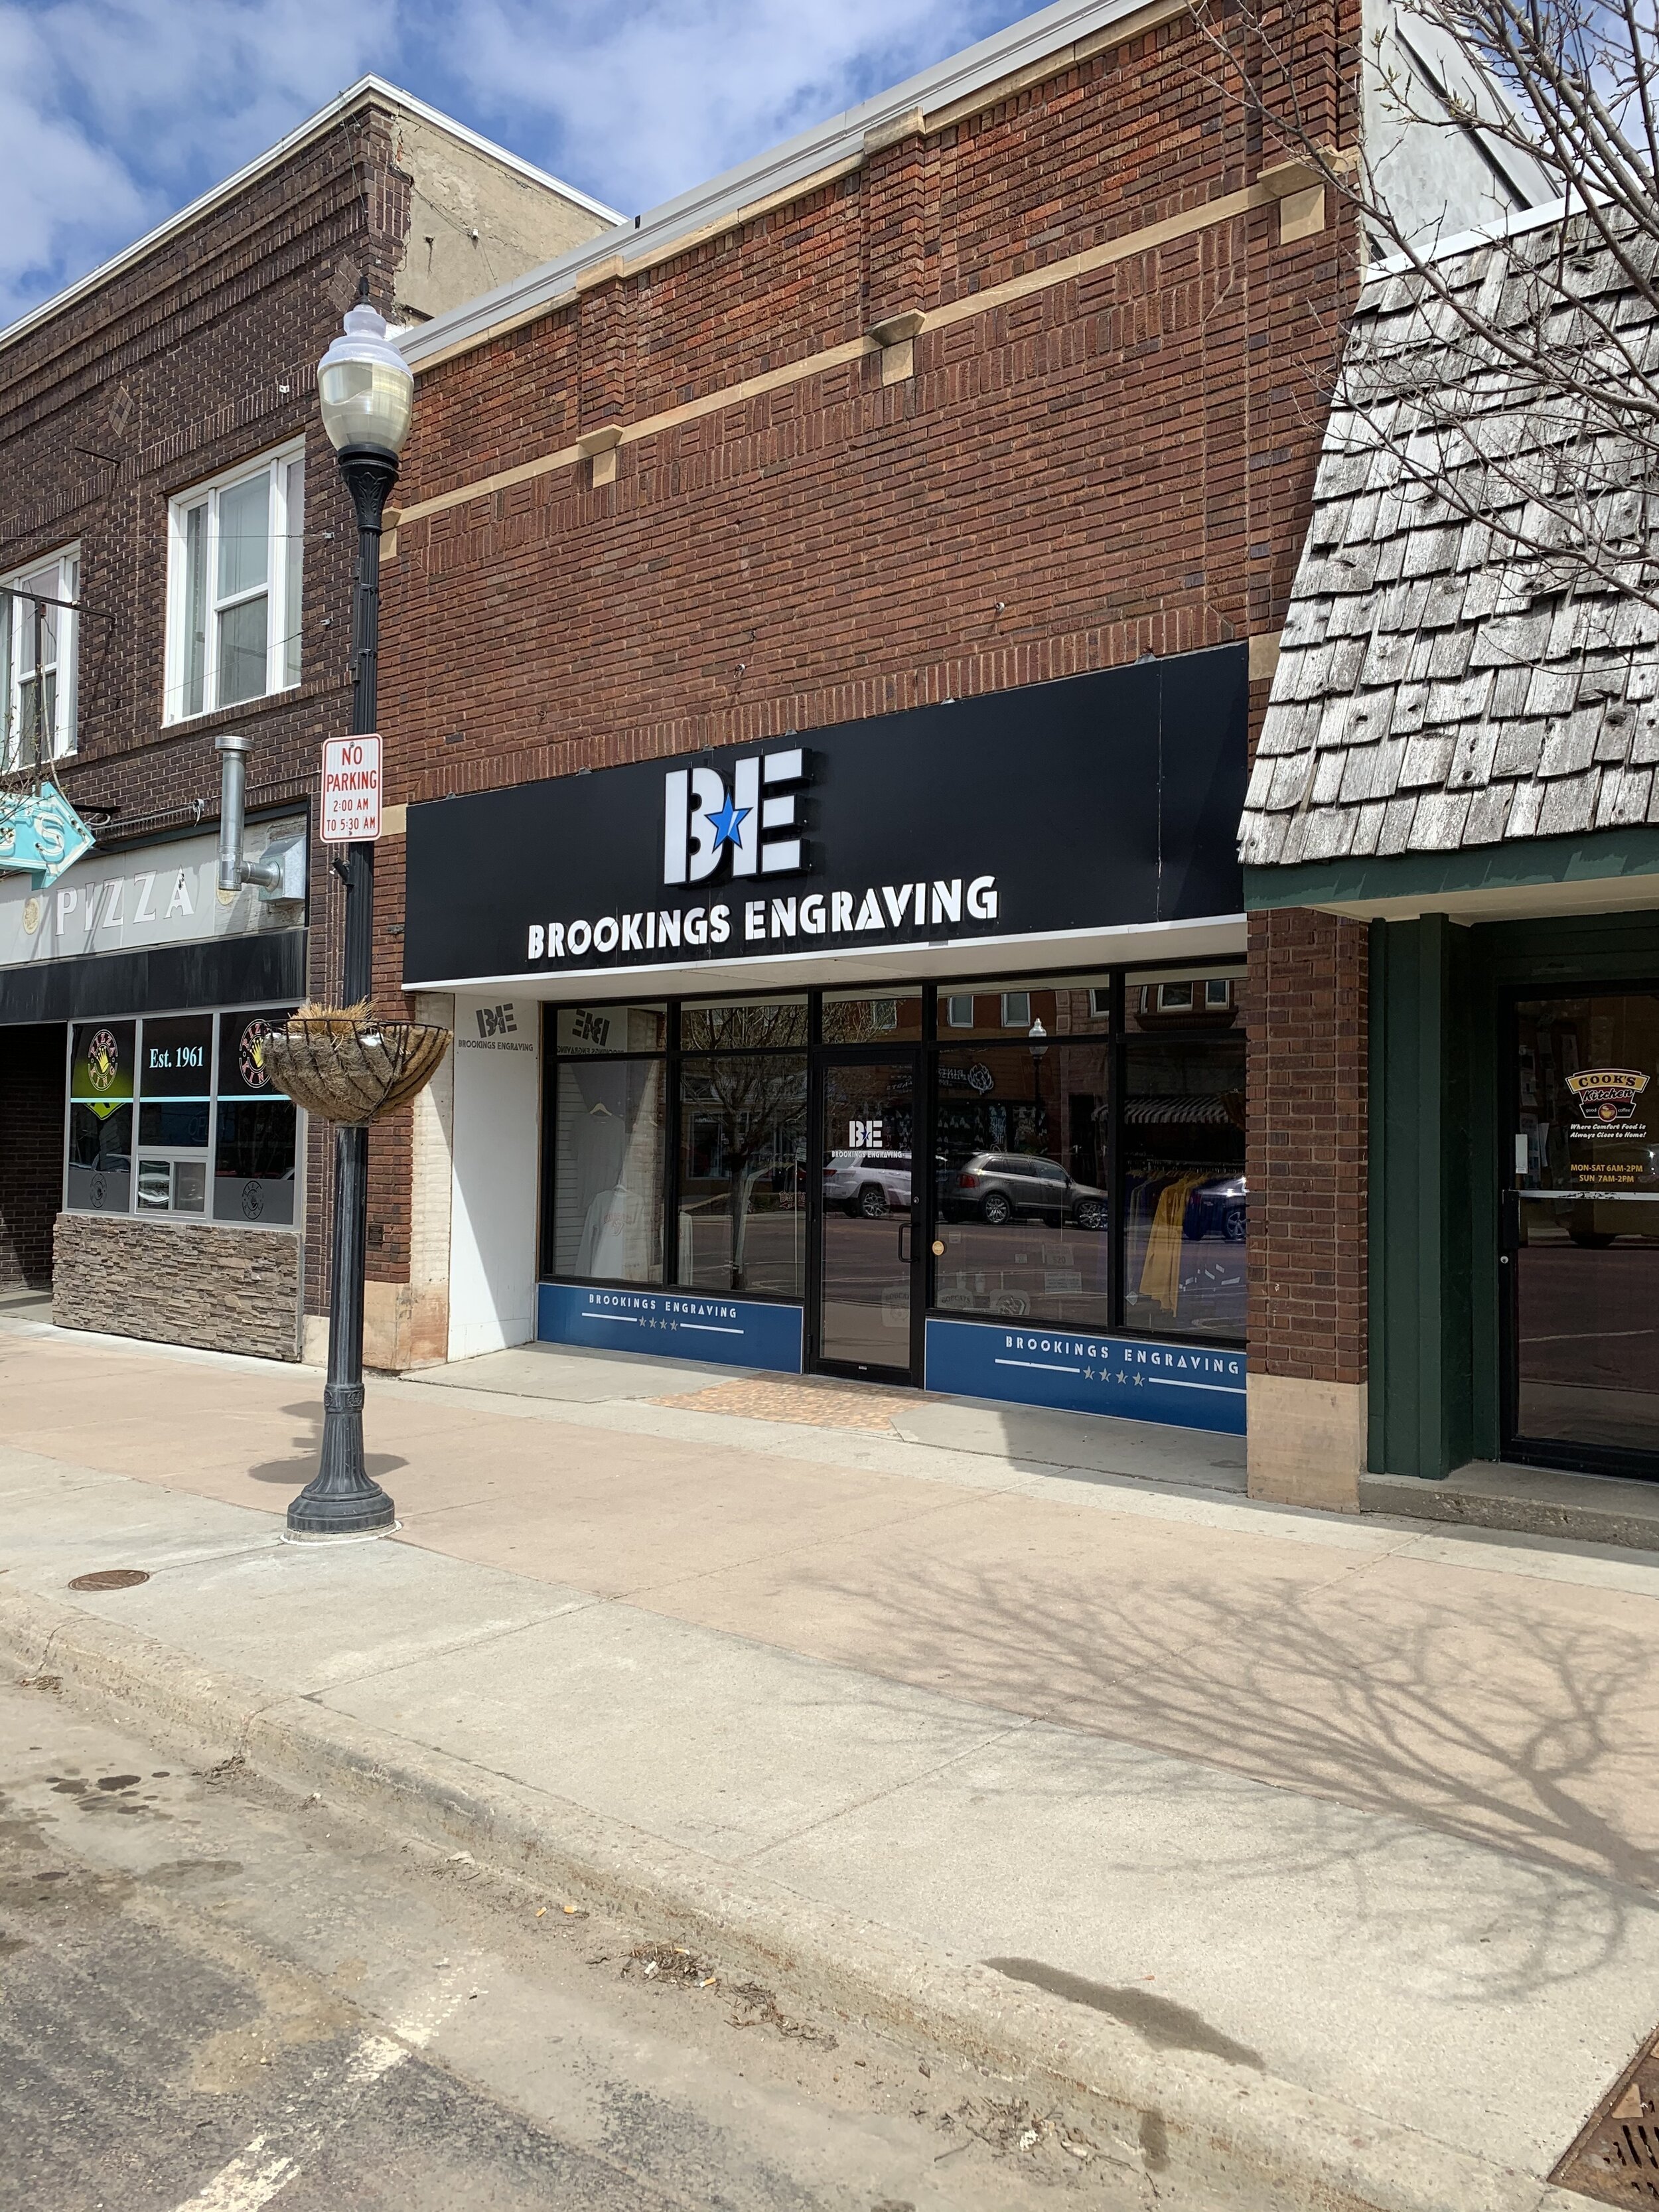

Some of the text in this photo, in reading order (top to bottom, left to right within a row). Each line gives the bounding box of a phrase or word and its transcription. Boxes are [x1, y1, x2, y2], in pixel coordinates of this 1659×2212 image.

[342, 746, 362, 765] NO
[326, 770, 377, 792] PARKING
[333, 798, 368, 812] 2:00 AM
[664, 747, 804, 885] BE
[326, 816, 375, 831] TO 5:30 AM
[55, 865, 194, 936] PIZZA
[528, 875, 998, 960] BROOKINGS ENGRAVING
[90, 1033, 115, 1057] PIZZA
[459, 1039, 534, 1052] BROOKINGS ENGRAVING
[149, 1046, 203, 1069] Est. 1961
[90, 1065, 115, 1086] KING
[1578, 1075, 1636, 1088] COOK'S
[1583, 1088, 1633, 1102] Kitchen
[849, 1120, 883, 1147] BE
[589, 1293, 737, 1318] BROOKINGS ENGRAVING
[1005, 1335, 1239, 1374] BROOKINGS ENGRAVING
